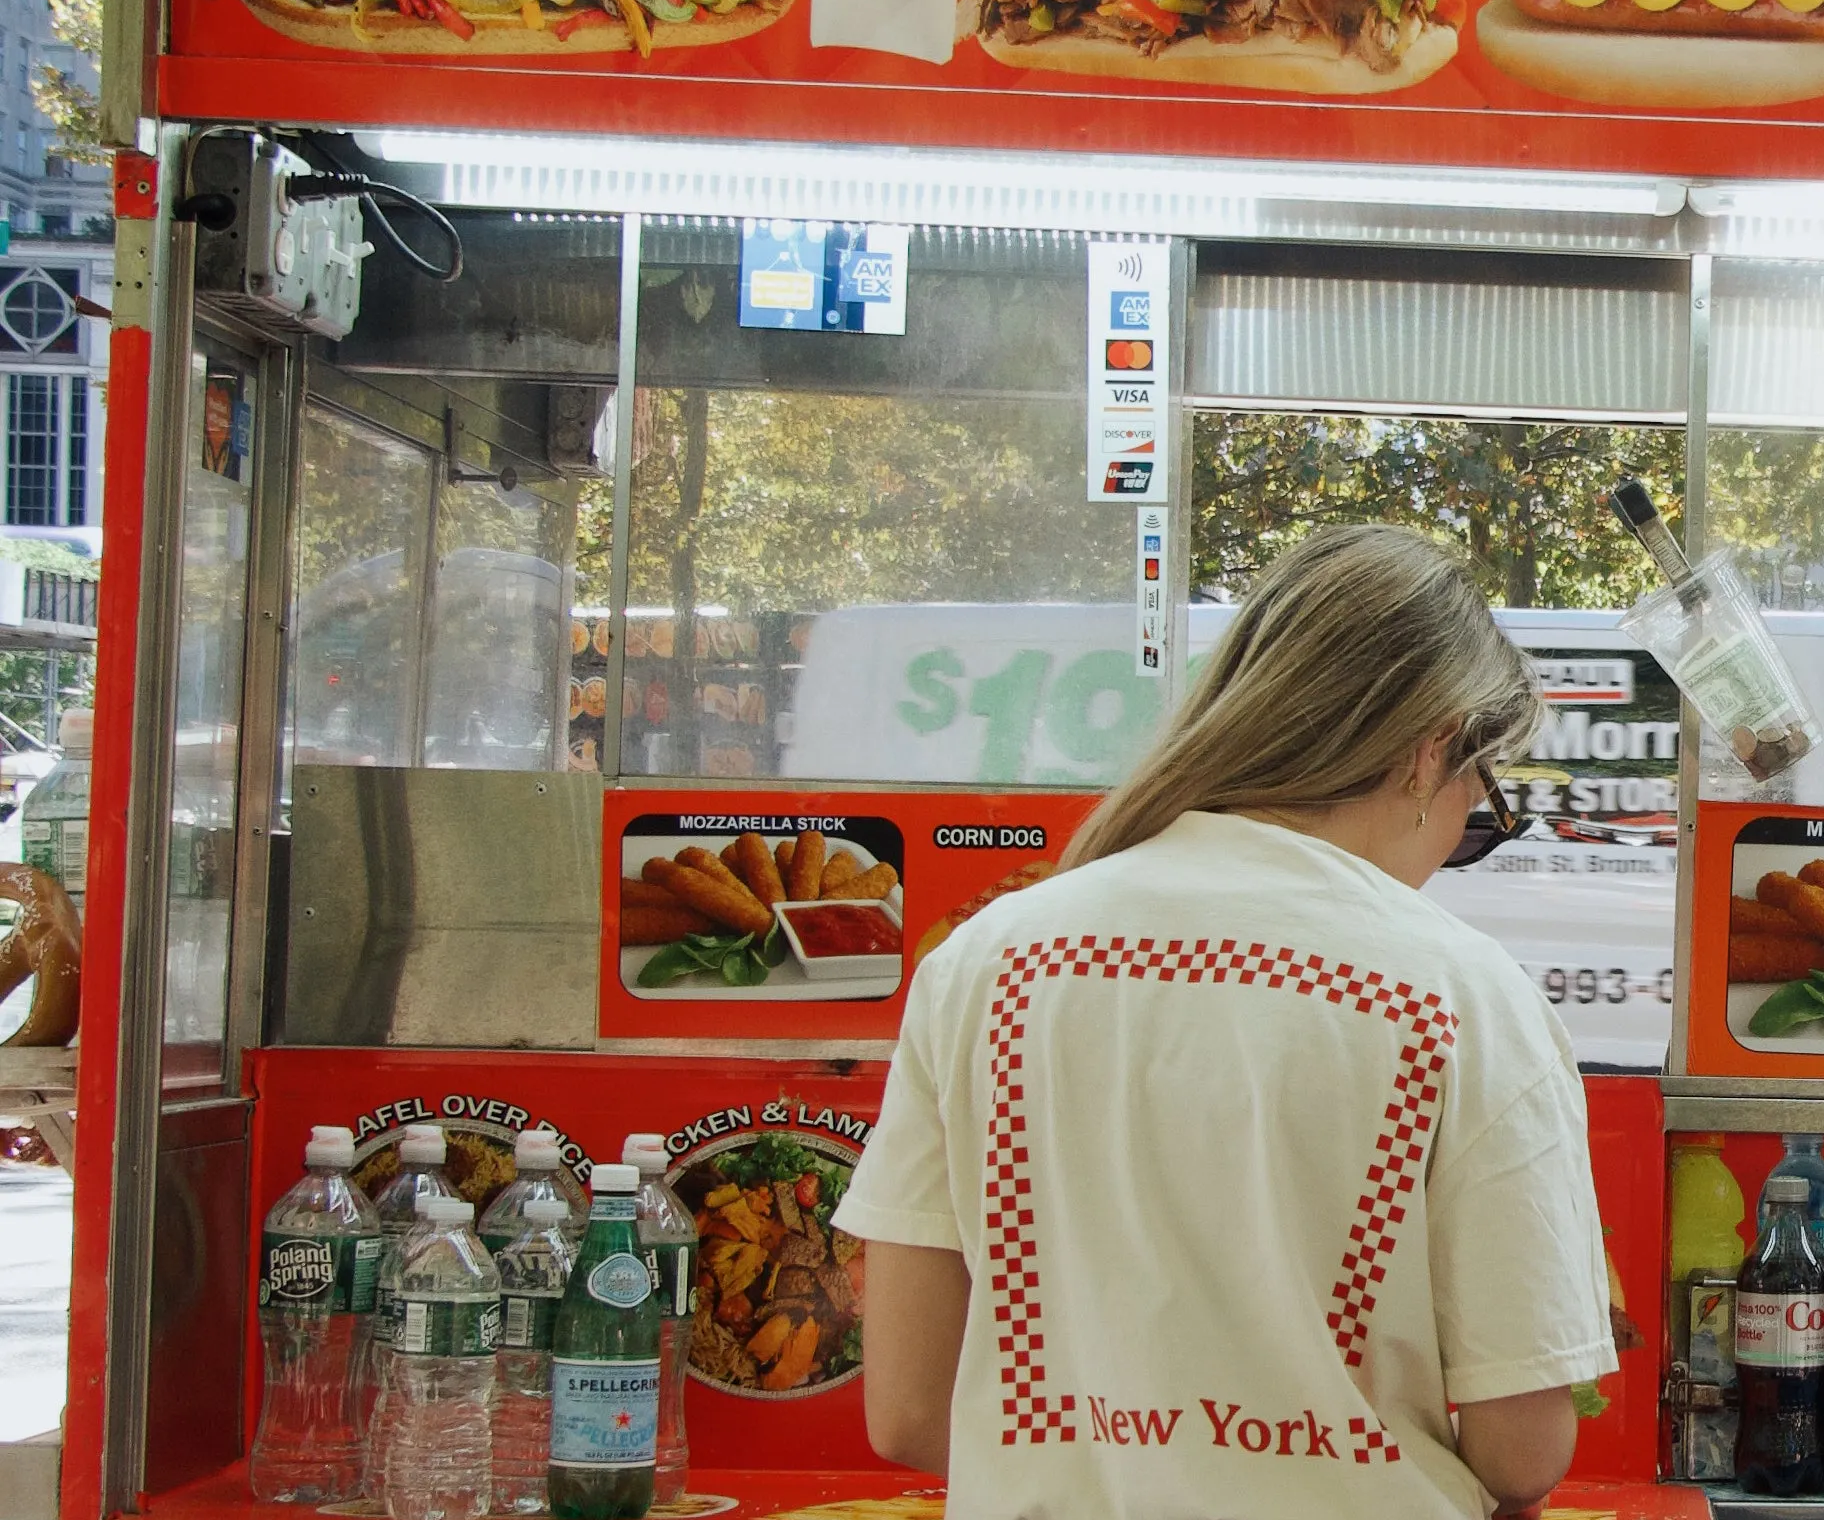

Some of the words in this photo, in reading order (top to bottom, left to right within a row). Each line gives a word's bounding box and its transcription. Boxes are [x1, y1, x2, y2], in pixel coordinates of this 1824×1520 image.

[855, 259, 892, 278] AM
[1119, 295, 1150, 312] AM
[1125, 312, 1149, 325] EX
[1112, 389, 1150, 403] VISA
[1526, 777, 1563, 813] &
[679, 815, 793, 832] MOZZARELLA
[796, 816, 846, 832] STICK
[935, 826, 994, 847] CORN
[998, 828, 1045, 849] DOG
[352, 1097, 434, 1144] AFEL
[441, 1094, 530, 1131] OVER
[760, 1101, 789, 1123] &
[269, 1241, 332, 1270] Poland
[269, 1261, 334, 1291] Spring
[1087, 1395, 1184, 1447] New
[1199, 1397, 1341, 1461] York
